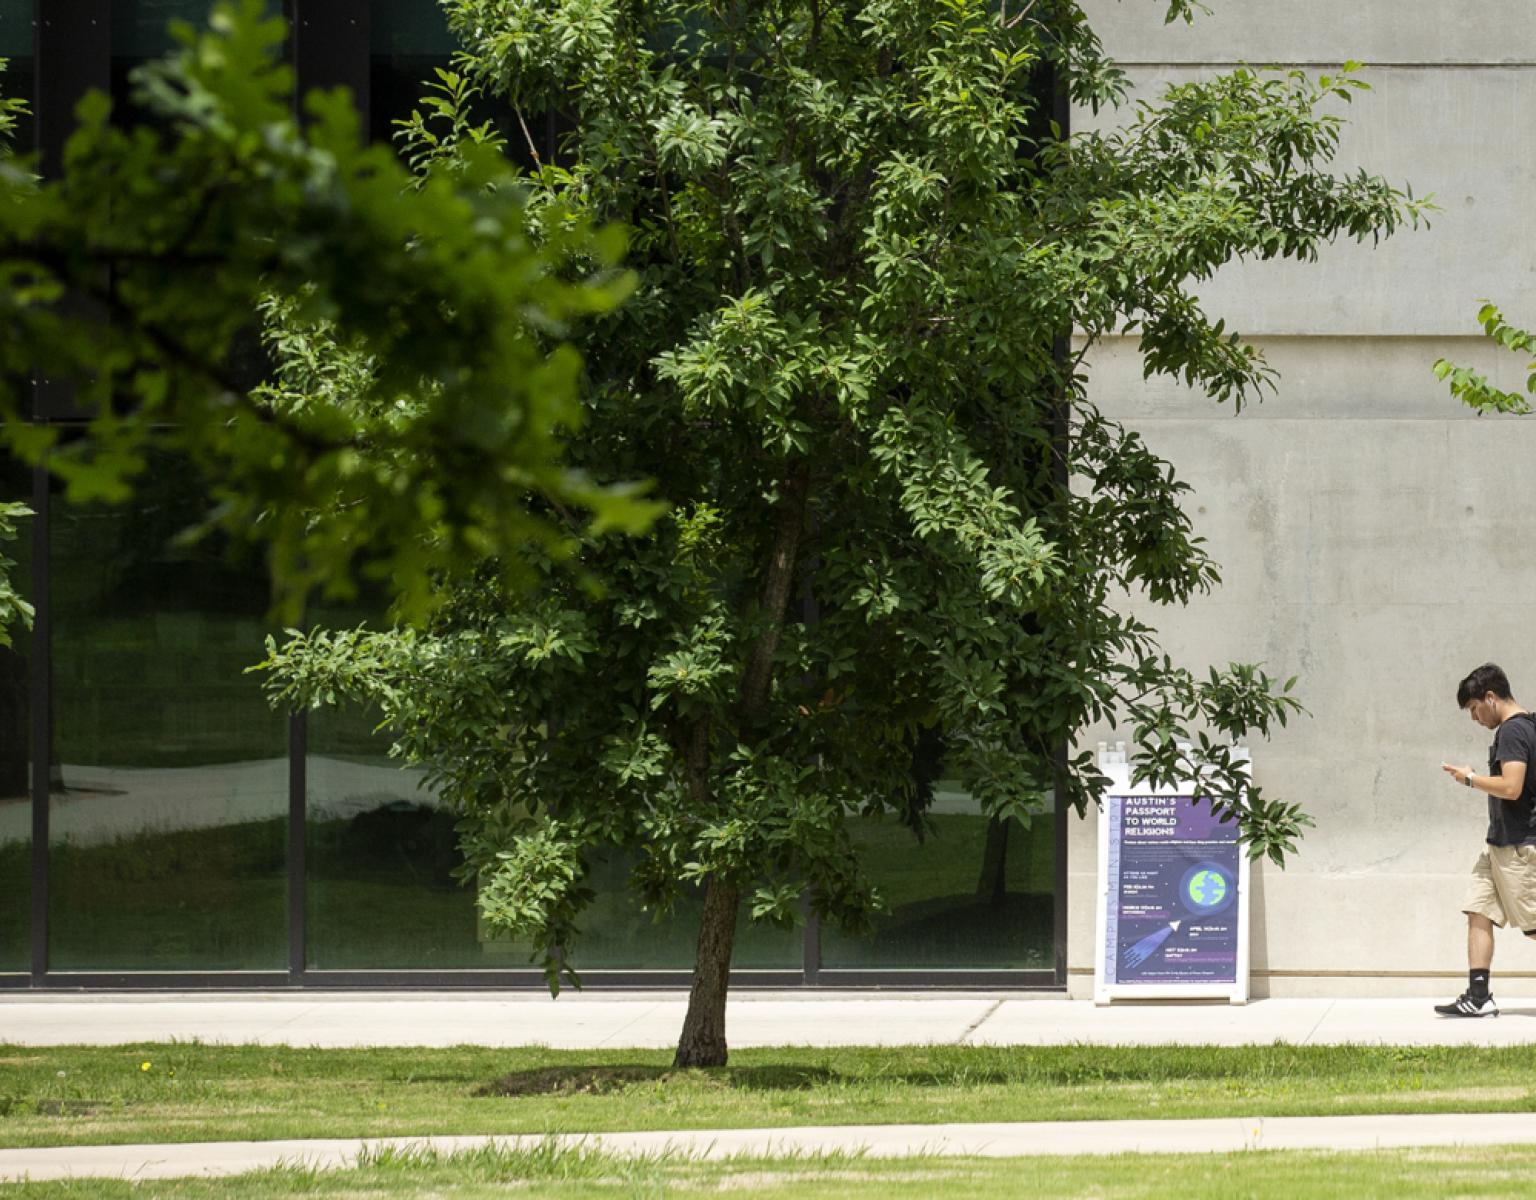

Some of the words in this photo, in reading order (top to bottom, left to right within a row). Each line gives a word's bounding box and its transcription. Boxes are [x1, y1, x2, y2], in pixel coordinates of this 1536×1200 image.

[1126, 798, 1176, 806] AUSTIN'S
[1109, 802, 1120, 892] MINISTRY
[1125, 828, 1174, 836] RELIGIONS
[1106, 899, 1116, 976] CAMPUS
